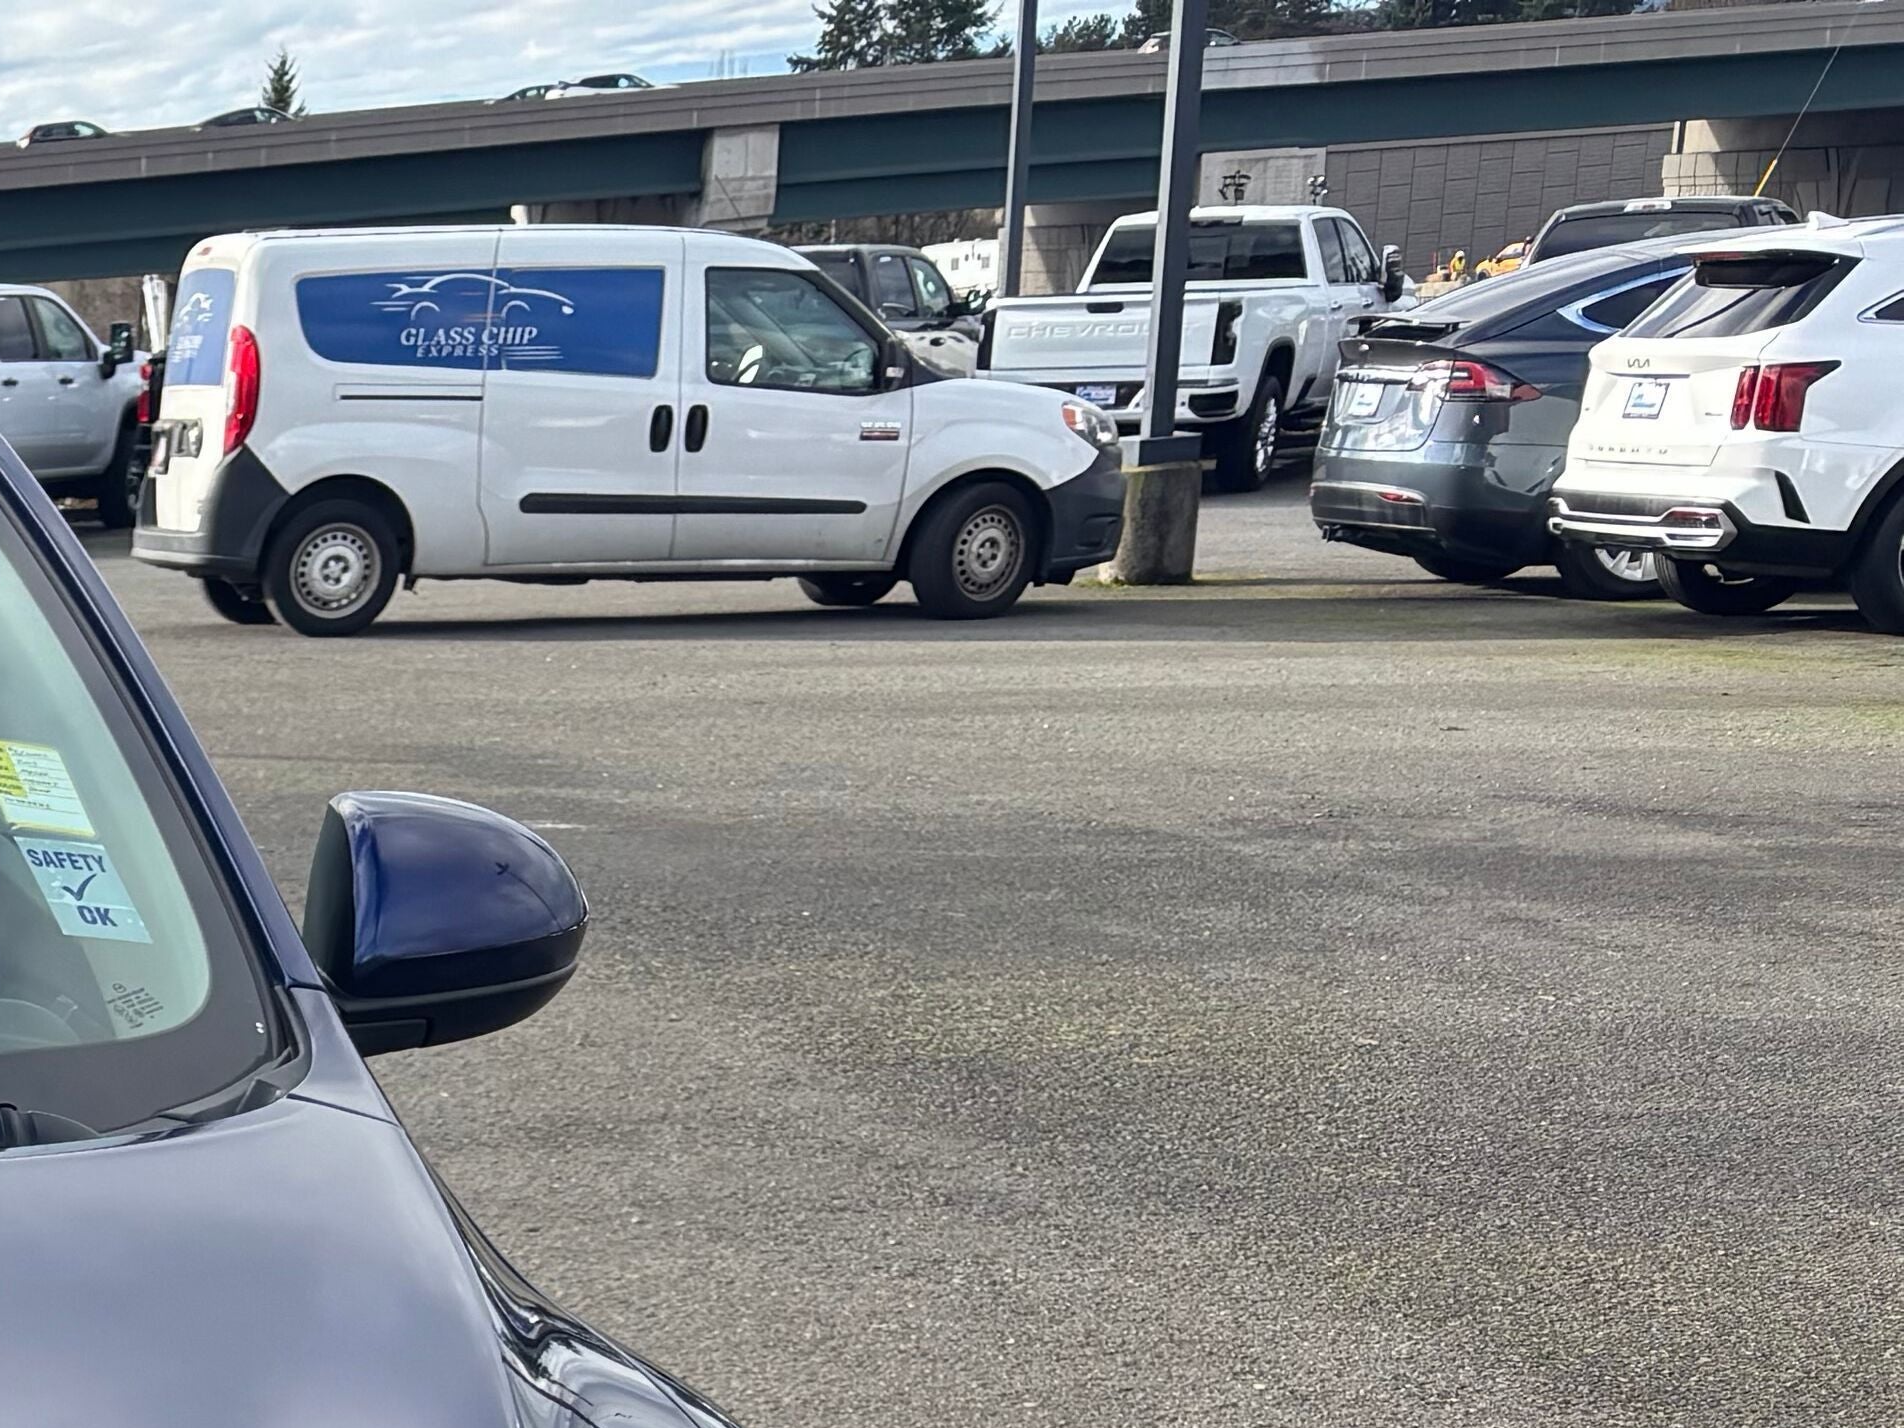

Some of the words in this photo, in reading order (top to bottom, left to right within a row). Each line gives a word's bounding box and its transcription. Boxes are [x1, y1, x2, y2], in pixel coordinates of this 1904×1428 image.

[400, 327, 476, 346] GLASS
[482, 326, 538, 345] CHIP
[416, 344, 499, 358] EXPRESS
[26, 848, 107, 873] SAFETY
[77, 905, 118, 927] OK
